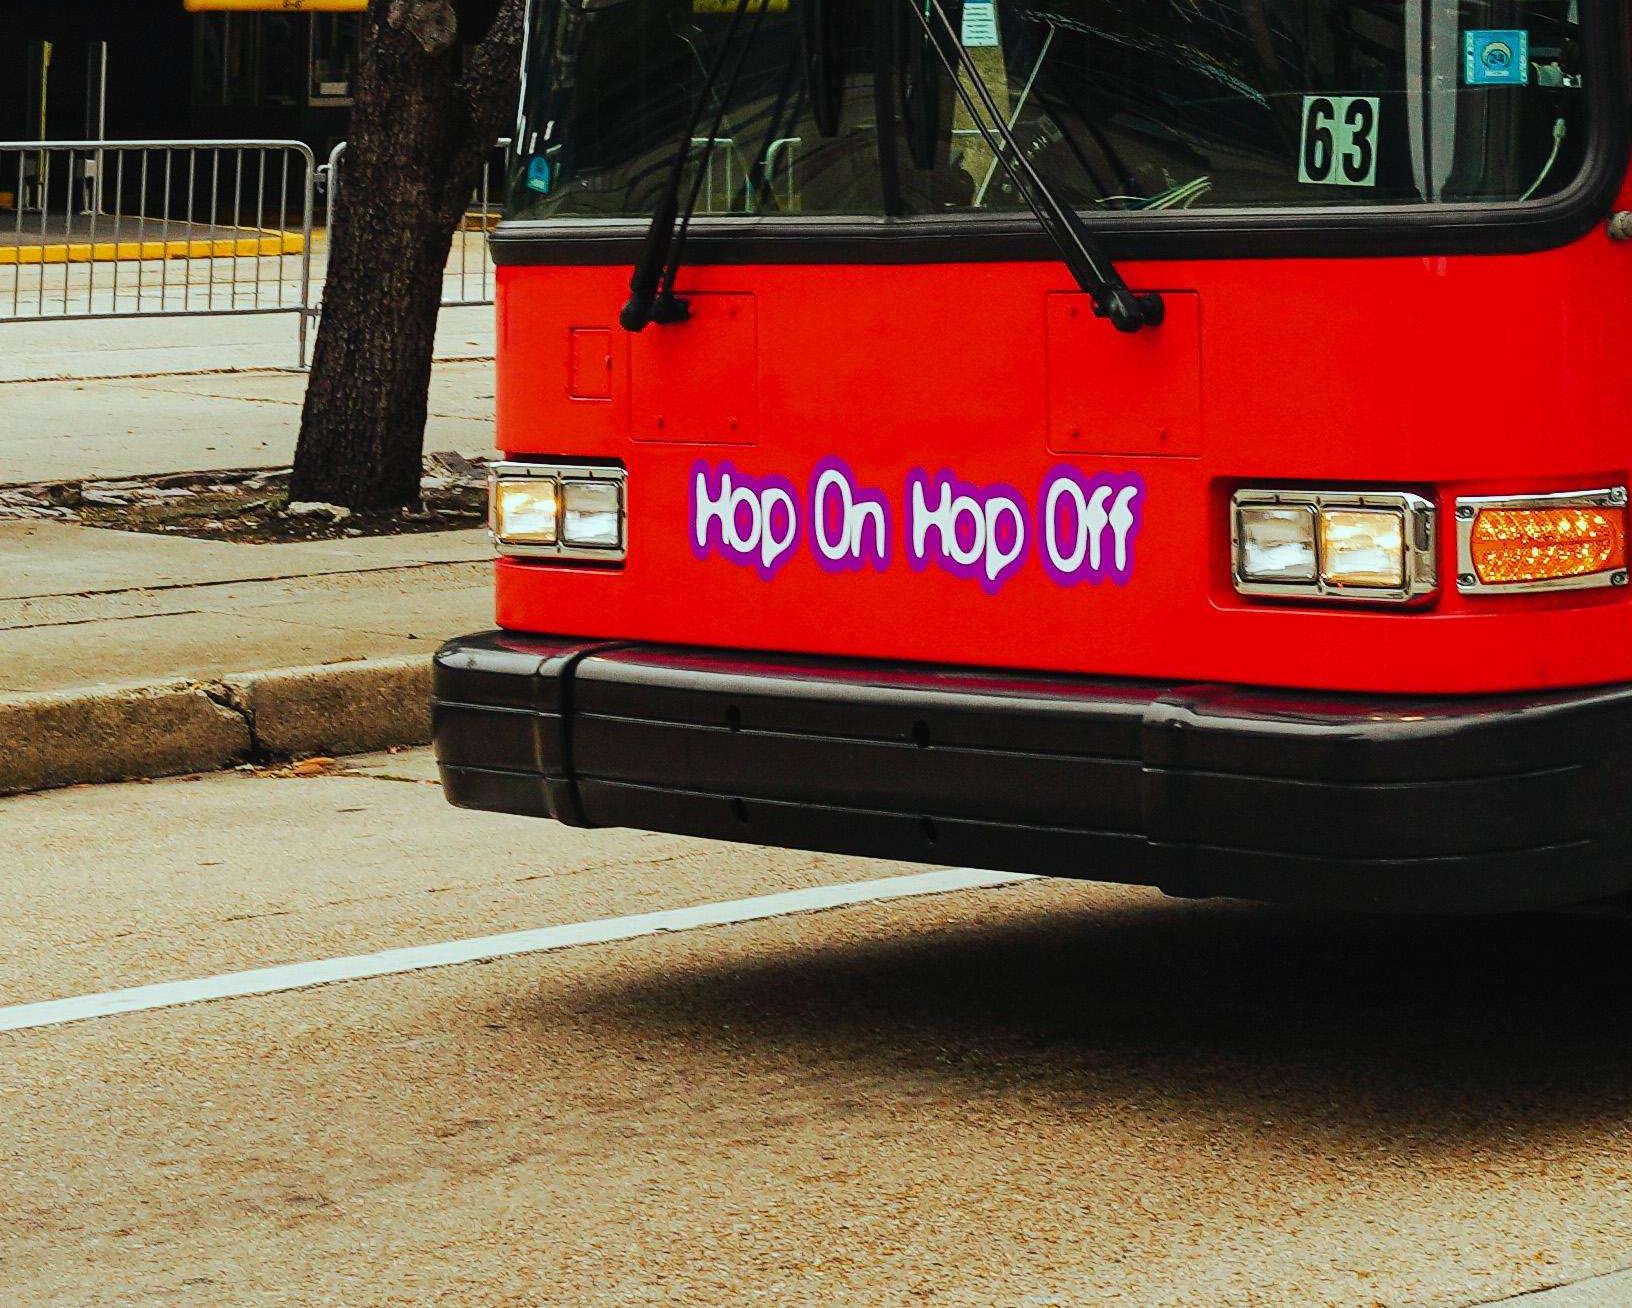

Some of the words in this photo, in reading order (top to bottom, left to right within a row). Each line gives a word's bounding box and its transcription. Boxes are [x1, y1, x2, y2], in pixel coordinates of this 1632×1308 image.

[1304, 97, 1374, 183] 63
[696, 471, 796, 568] Hop
[813, 468, 886, 561] On
[912, 480, 1024, 580] Hop
[1042, 477, 1138, 574] Off
